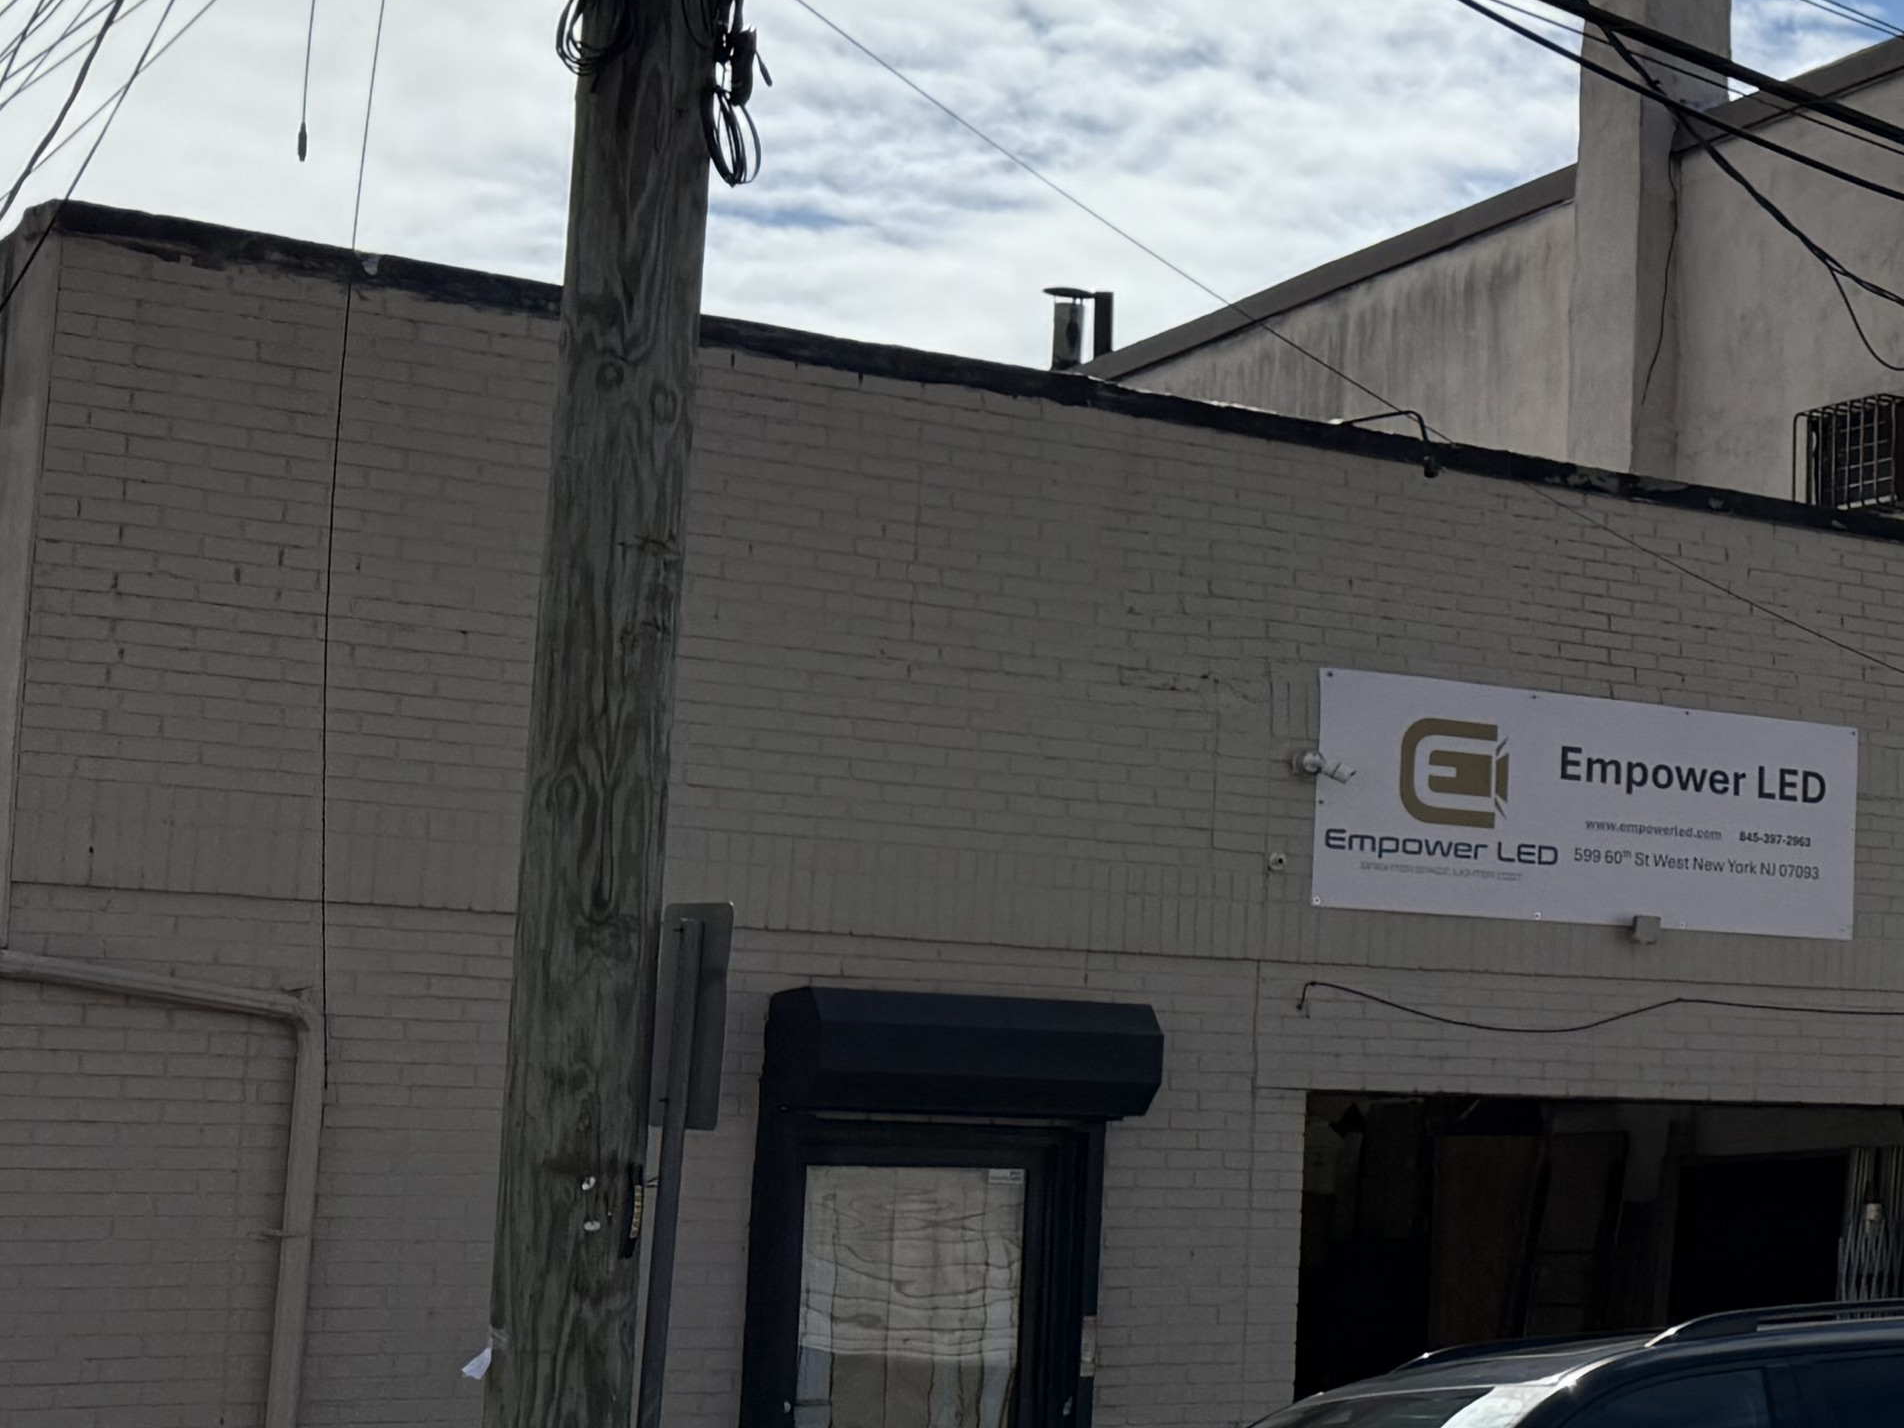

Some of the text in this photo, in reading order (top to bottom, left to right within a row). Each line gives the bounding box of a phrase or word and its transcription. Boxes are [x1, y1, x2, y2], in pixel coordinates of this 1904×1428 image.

[1560, 745, 1826, 804] Empower LED
[1325, 828, 1558, 866] Empower LED
[1585, 820, 1722, 840] www.empowerled.com
[1574, 847, 1601, 863] 599
[1634, 852, 1650, 867] St
[1653, 853, 1689, 870] West
[1693, 856, 1725, 872] New
[1727, 858, 1757, 875] York
[1760, 862, 1776, 876] NJ
[1778, 864, 1820, 880] 07093
